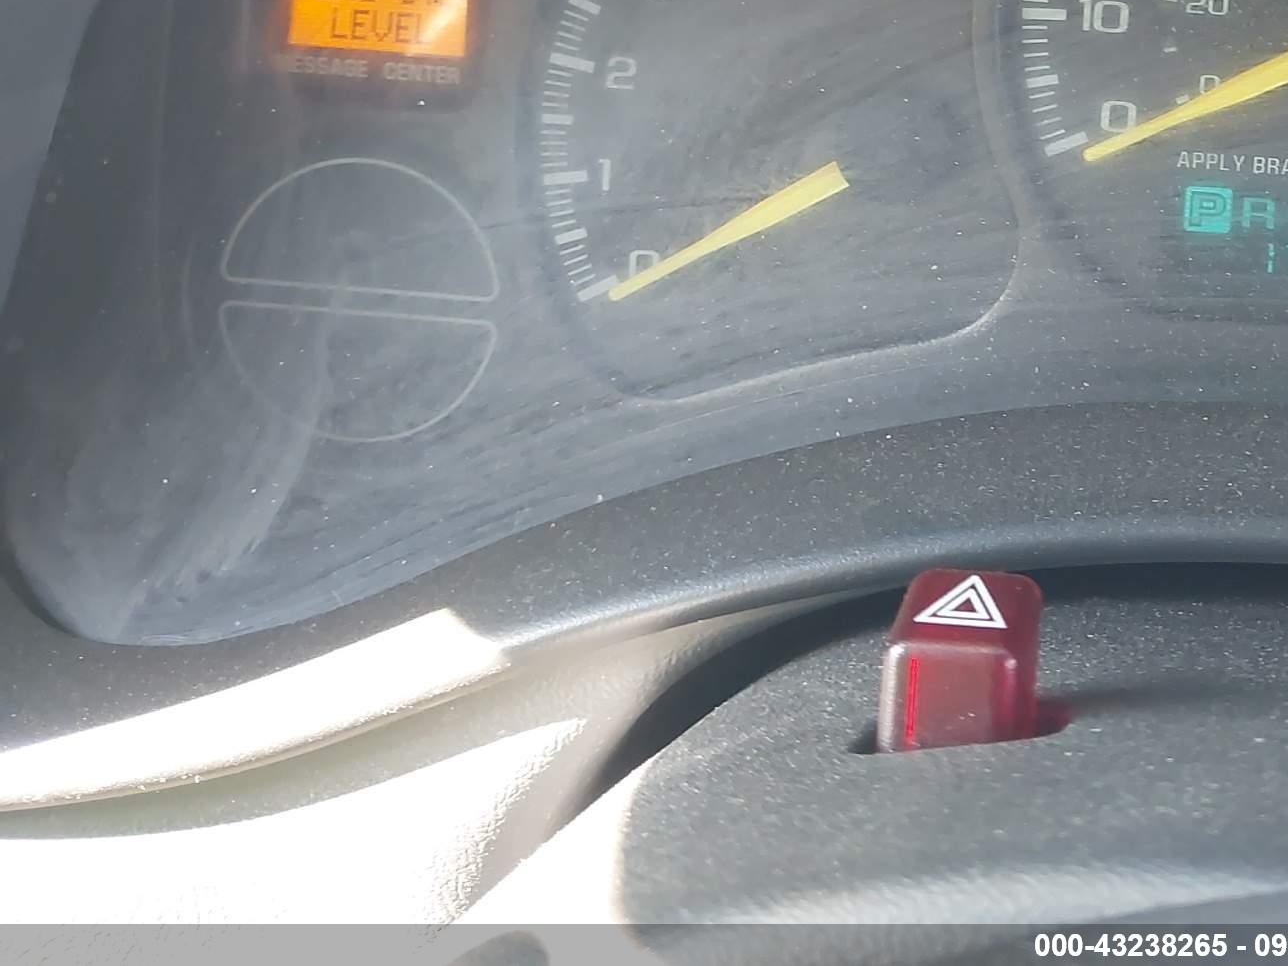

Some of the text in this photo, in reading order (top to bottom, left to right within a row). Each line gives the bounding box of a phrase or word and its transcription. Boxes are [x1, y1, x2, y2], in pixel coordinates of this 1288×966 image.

[330, 7, 433, 44] LEVEL
[382, 60, 461, 85] CENTER
[605, 57, 638, 90] 2
[1100, 100, 1137, 133] 0
[598, 159, 611, 191] 1
[1176, 151, 1245, 172] APPLY
[1187, 189, 1231, 231] P
